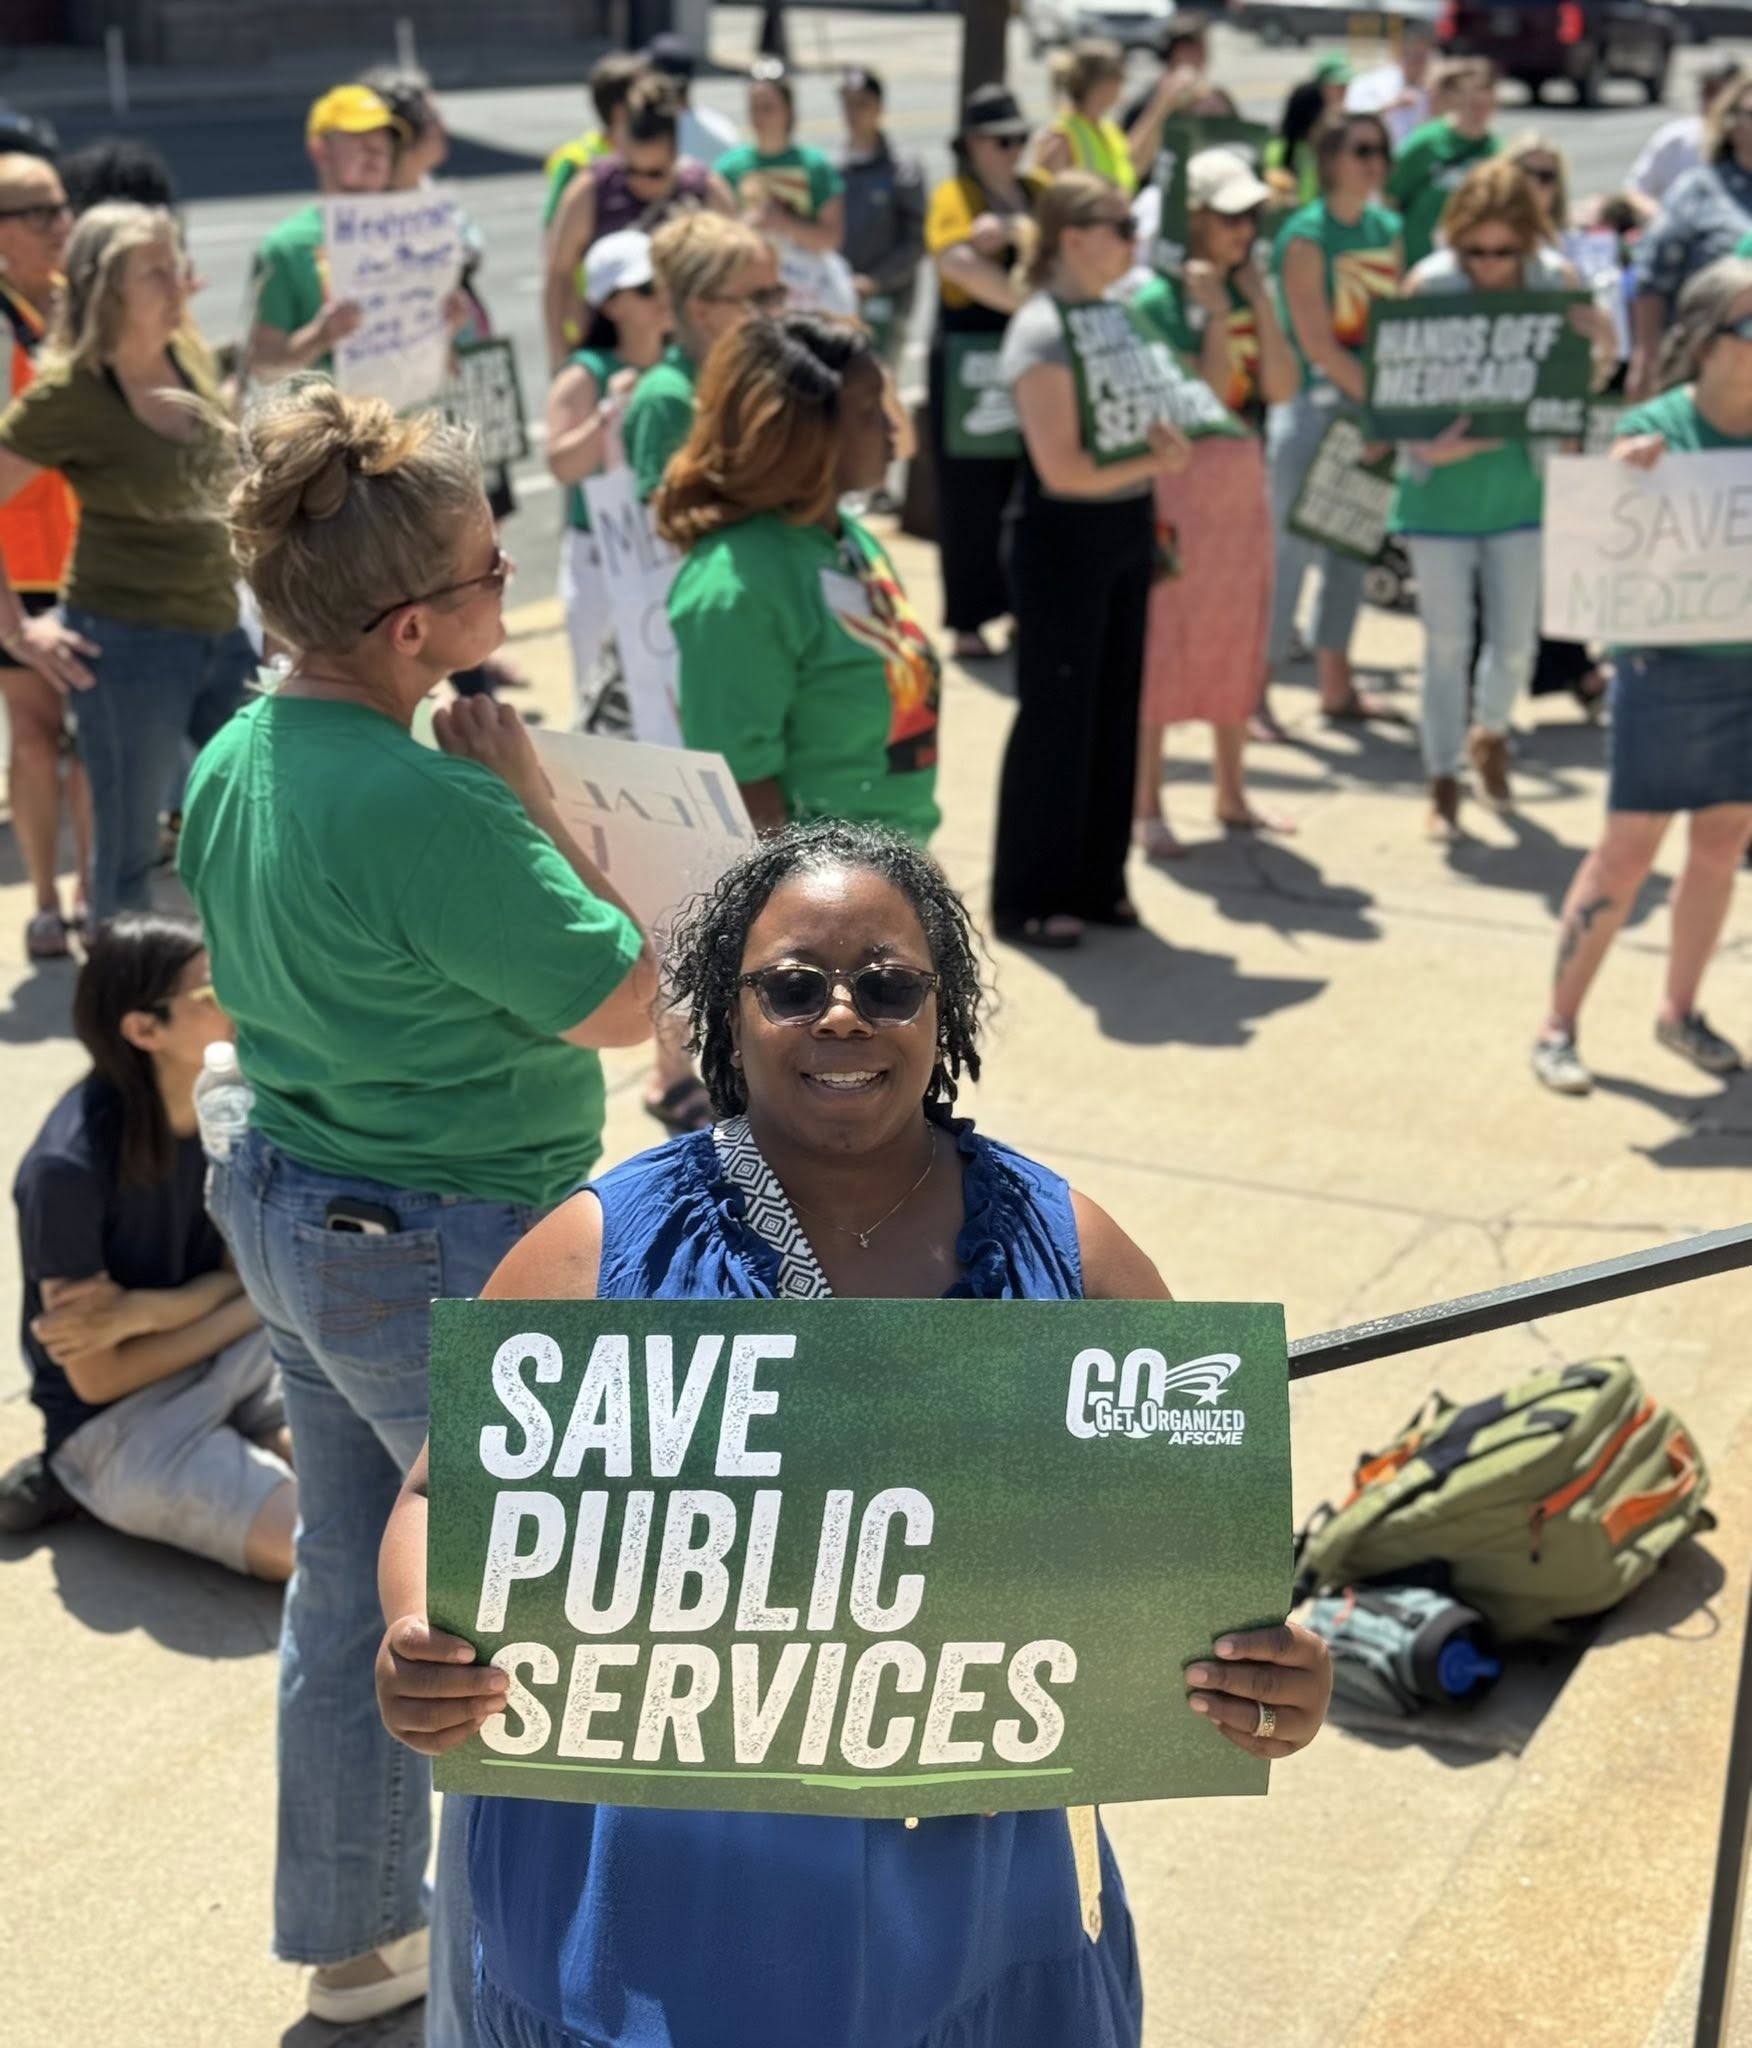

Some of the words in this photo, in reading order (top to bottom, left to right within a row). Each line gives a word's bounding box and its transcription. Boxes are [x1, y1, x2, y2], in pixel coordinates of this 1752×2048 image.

[1598, 484, 1752, 562] SAVE
[479, 1333, 797, 1479] SAVE
[1066, 1348, 1168, 1439] GO
[1096, 1400, 1135, 1432] GET
[1141, 1401, 1245, 1432] ORGANIZED
[1168, 1432, 1243, 1445] AFSCME
[476, 1487, 934, 1635] PUBLIC
[480, 1639, 1077, 1769] SERVICES
